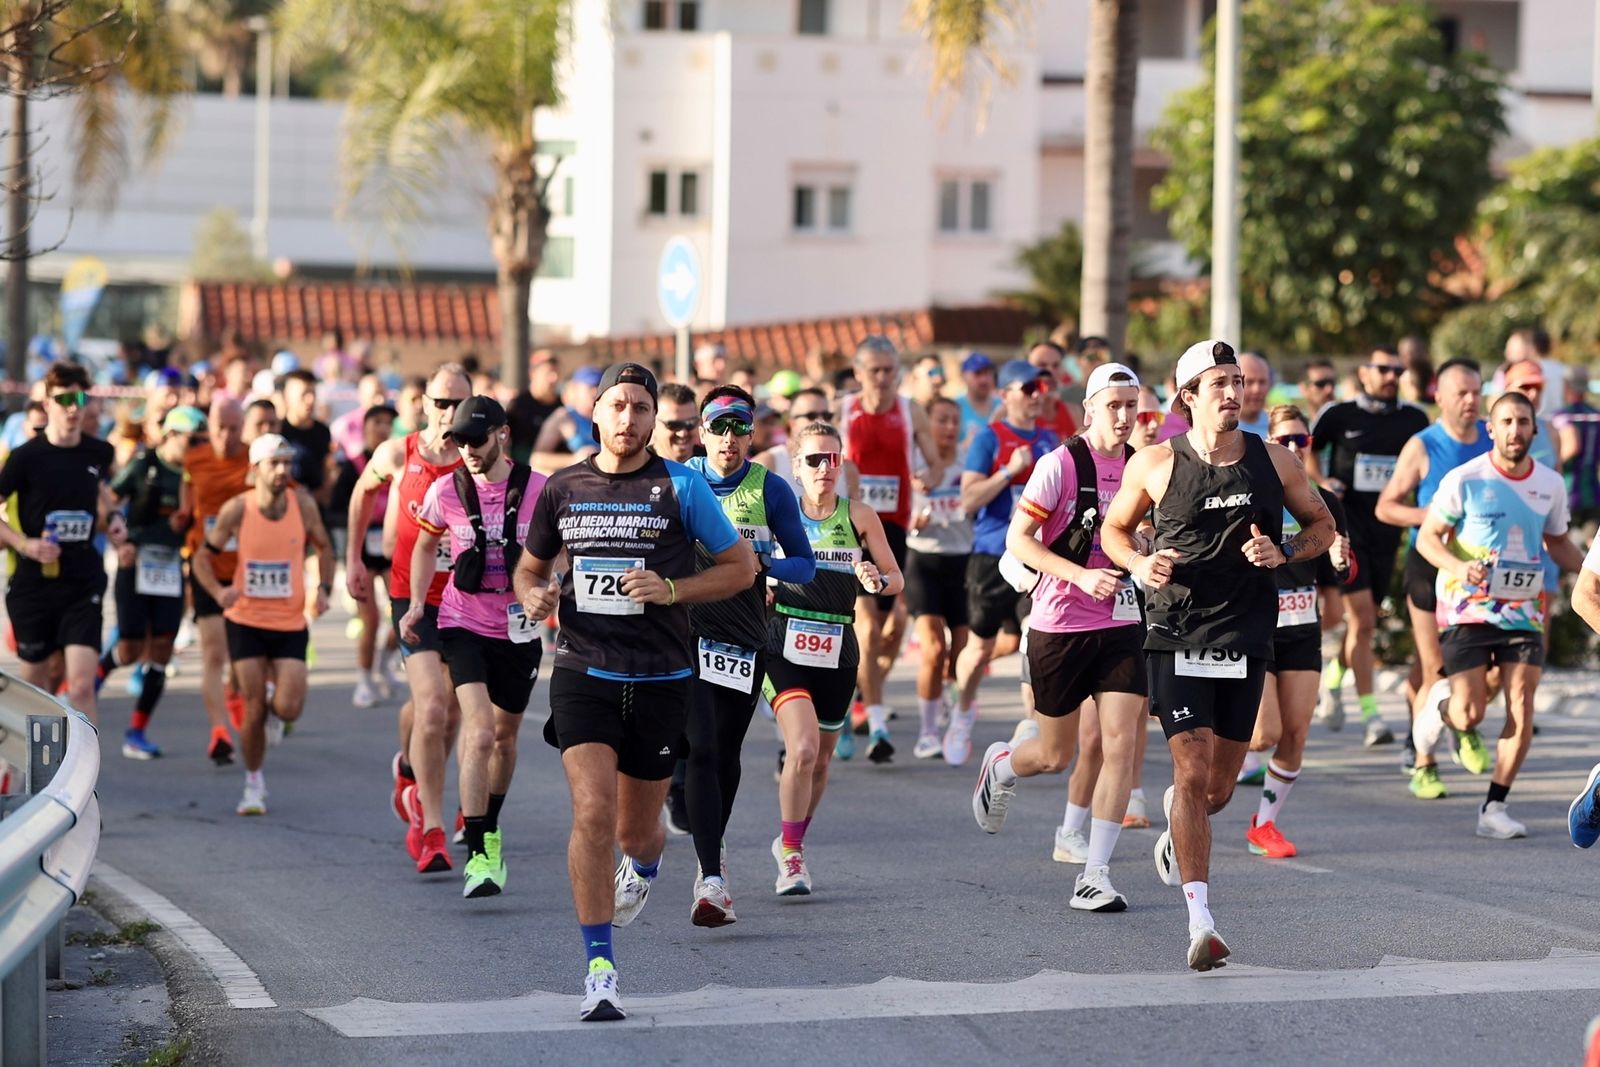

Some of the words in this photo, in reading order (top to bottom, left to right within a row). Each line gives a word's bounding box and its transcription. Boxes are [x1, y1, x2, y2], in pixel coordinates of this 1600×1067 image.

[569, 503, 652, 512] TORREMOLINOS
[1204, 493, 1253, 509] BMRK
[580, 515, 614, 527] MEDIA
[615, 515, 669, 529] MARATÓN
[562, 527, 639, 540] INTERNACIONAL
[640, 529, 660, 538] 2024
[625, 542, 655, 550] MARATHON
[814, 551, 853, 562] MOLINOS
[1503, 571, 1536, 587] 157
[795, 633, 833, 654] 894
[702, 652, 751, 678] 1878
